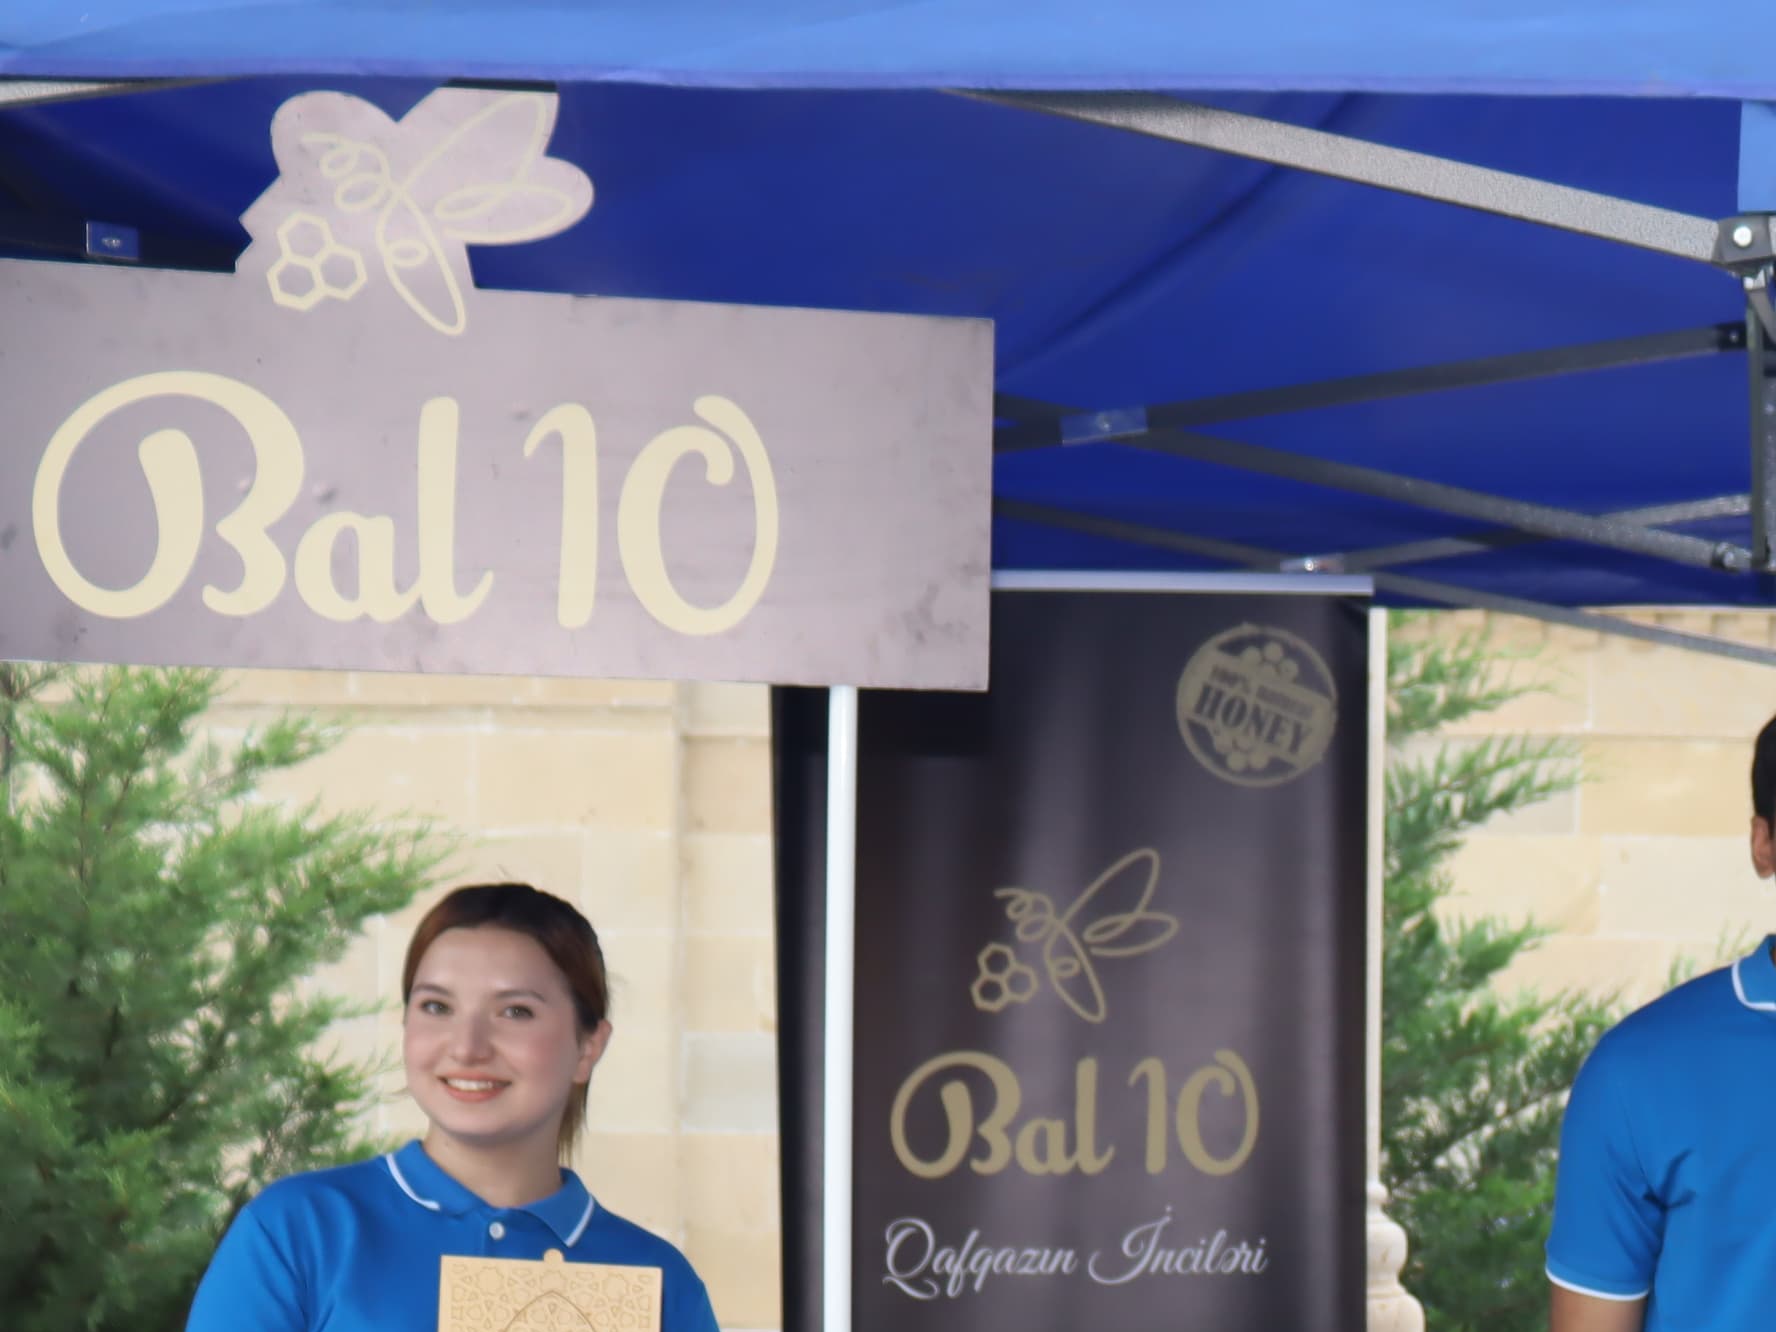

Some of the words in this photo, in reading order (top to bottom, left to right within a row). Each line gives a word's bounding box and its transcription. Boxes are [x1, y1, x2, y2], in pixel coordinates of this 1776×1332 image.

[33, 370, 494, 624] Bal
[523, 394, 779, 636] 10
[1193, 681, 1314, 755] HONEY
[891, 1051, 1114, 1178] Bal
[1129, 1049, 1259, 1176] 10
[1088, 1204, 1268, 1285] İnciləri
